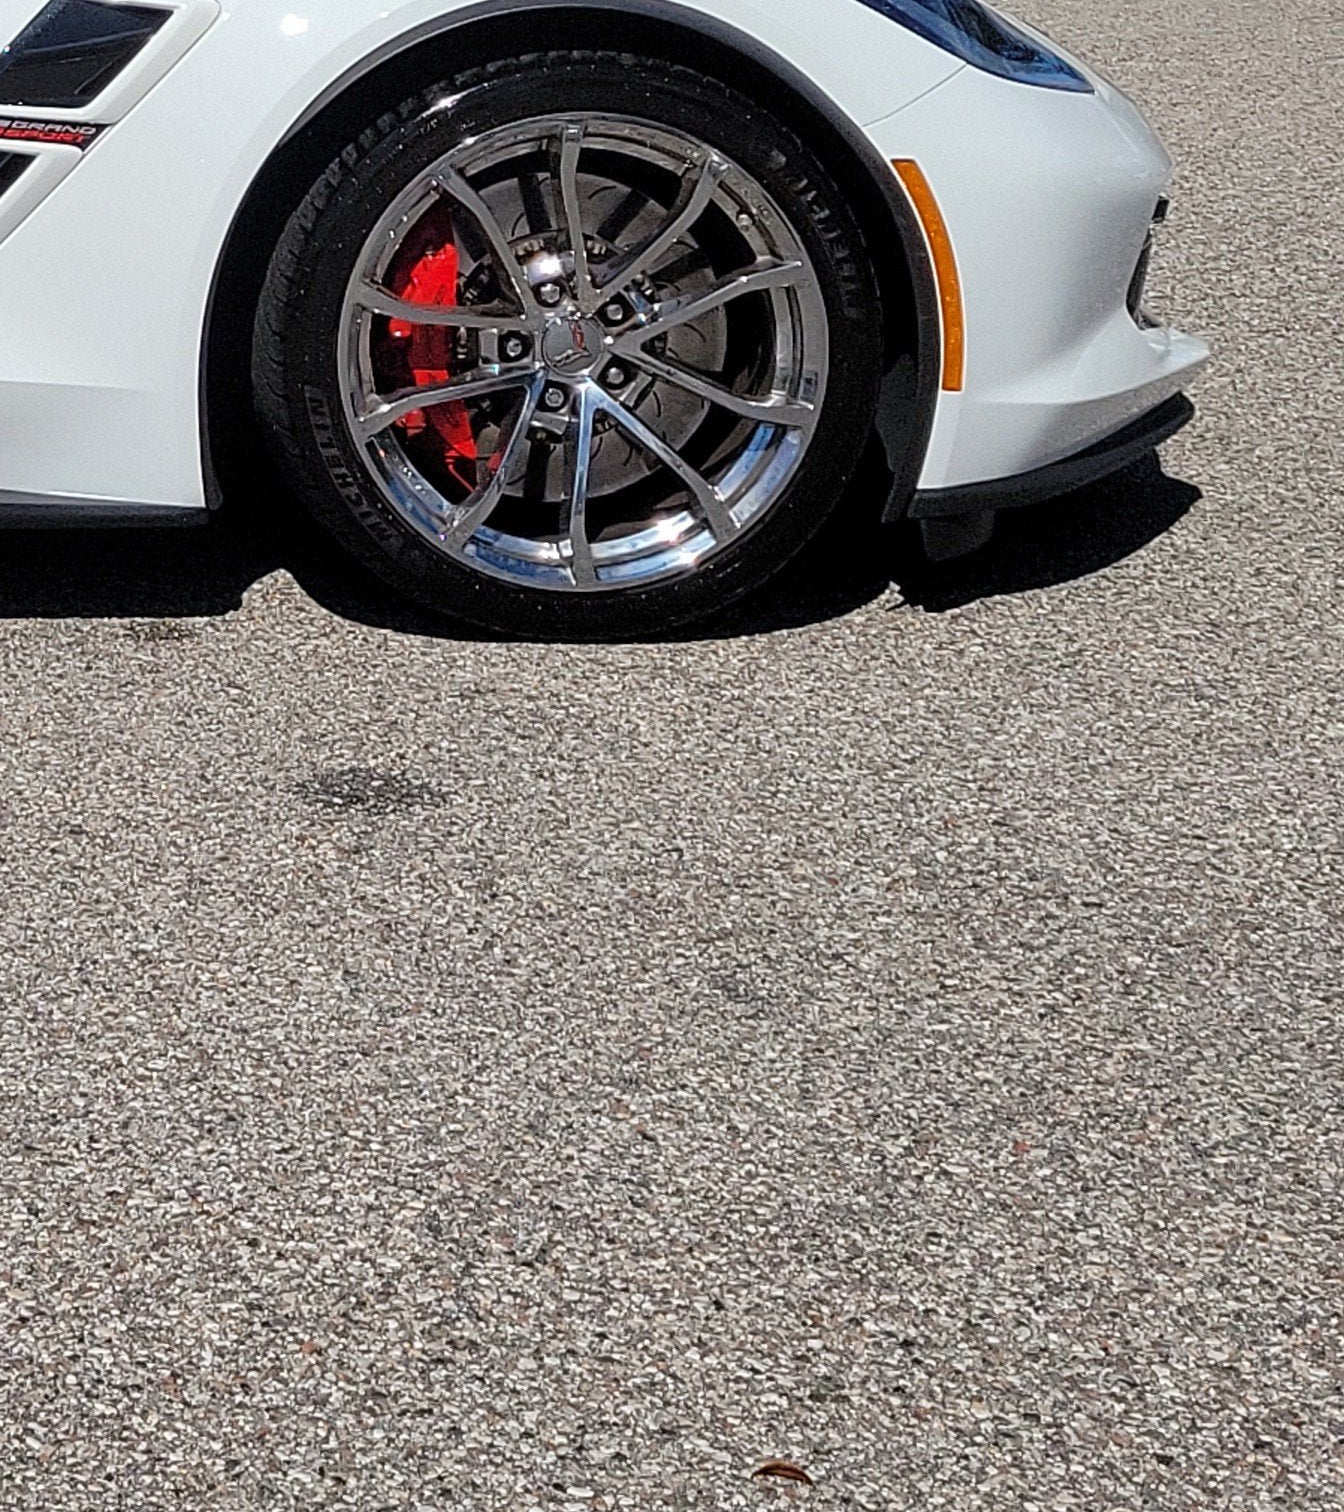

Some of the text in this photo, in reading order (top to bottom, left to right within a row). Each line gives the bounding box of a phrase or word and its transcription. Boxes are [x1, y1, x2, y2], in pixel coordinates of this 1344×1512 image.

[12, 121, 96, 134] GRAND
[4, 130, 85, 142] SPORT
[307, 396, 395, 544] MICHELIN
